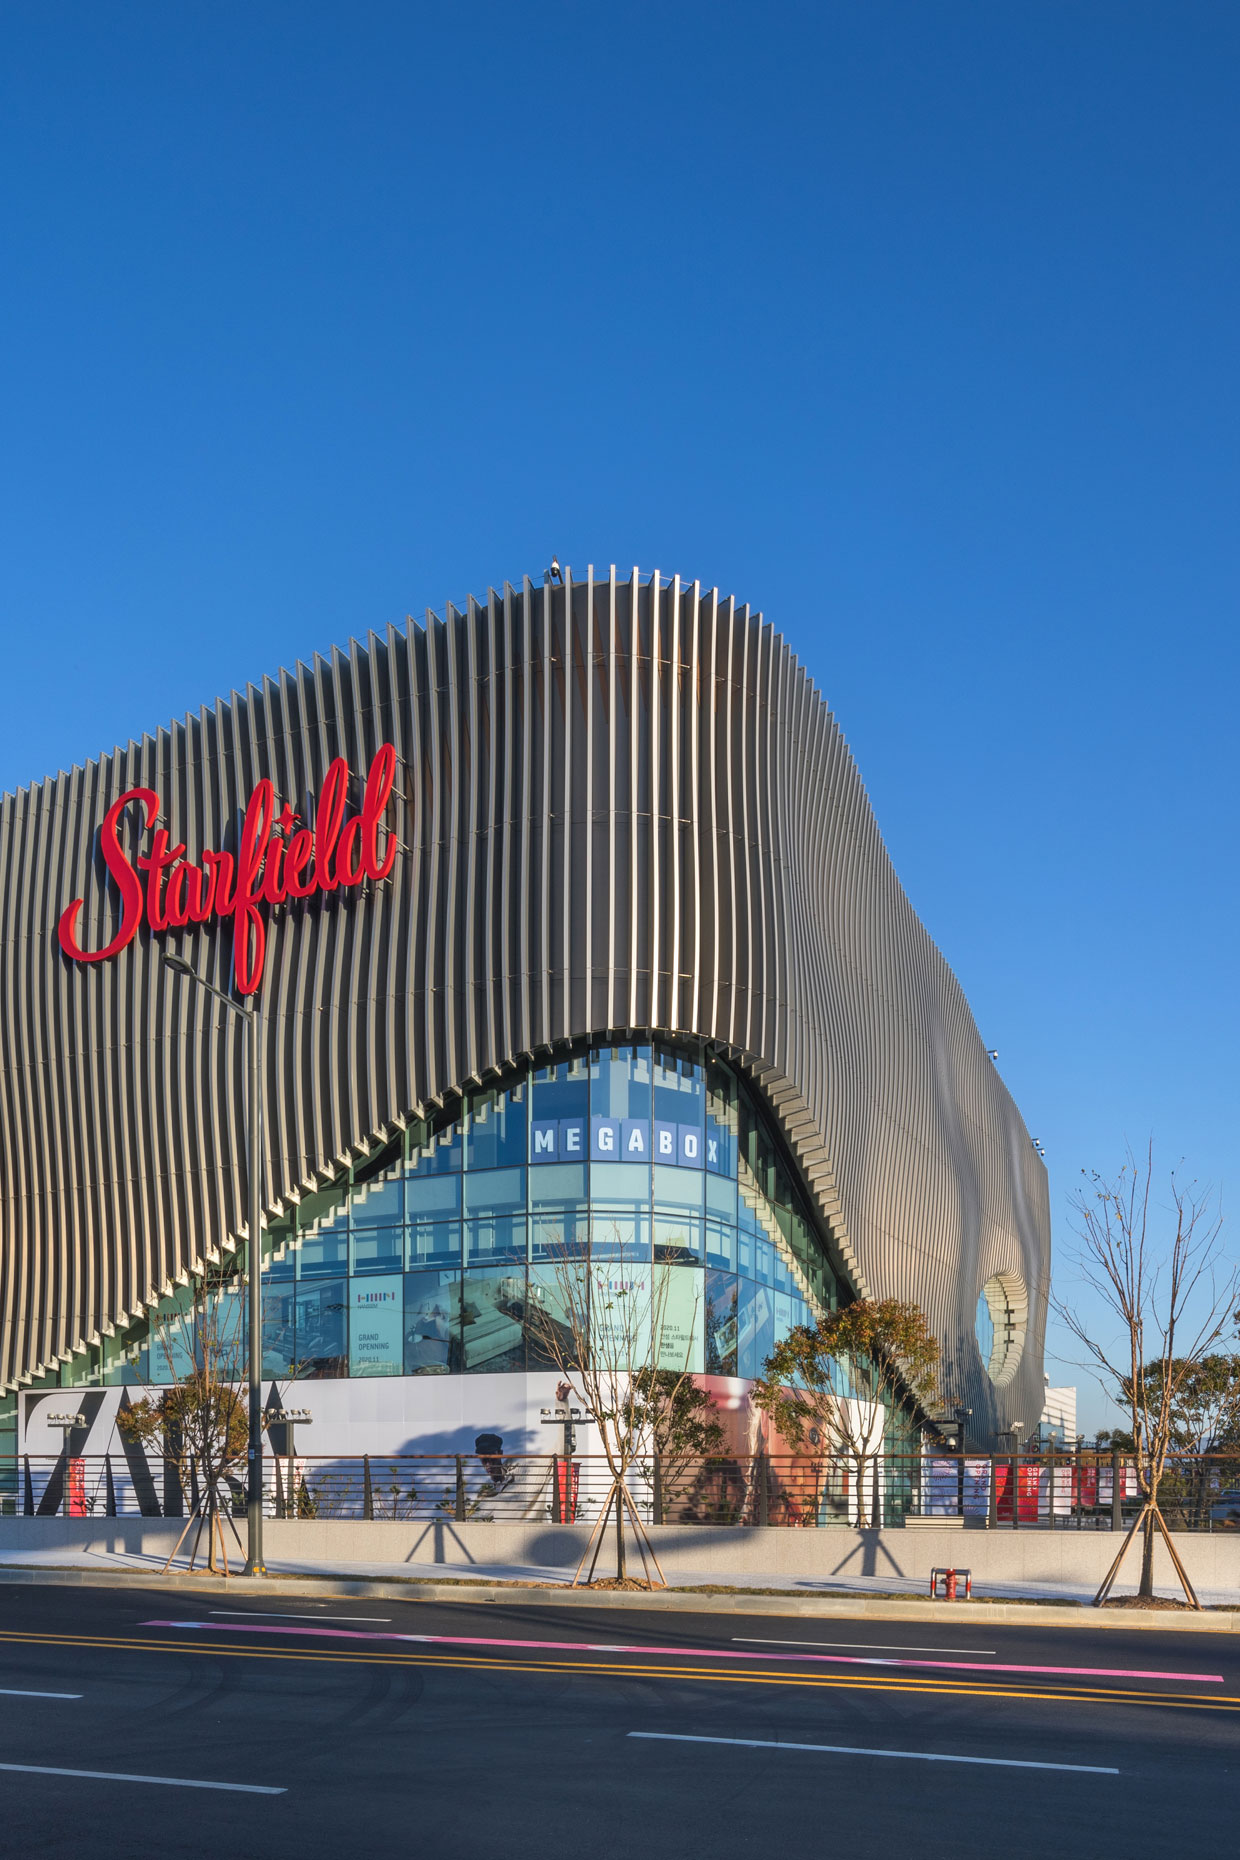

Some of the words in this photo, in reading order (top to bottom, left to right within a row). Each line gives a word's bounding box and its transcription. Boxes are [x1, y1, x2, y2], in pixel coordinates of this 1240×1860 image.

[58, 743, 396, 994] Starfield
[534, 1127, 717, 1163] MEGABOX
[972, 1463, 981, 1499] OPENNG
